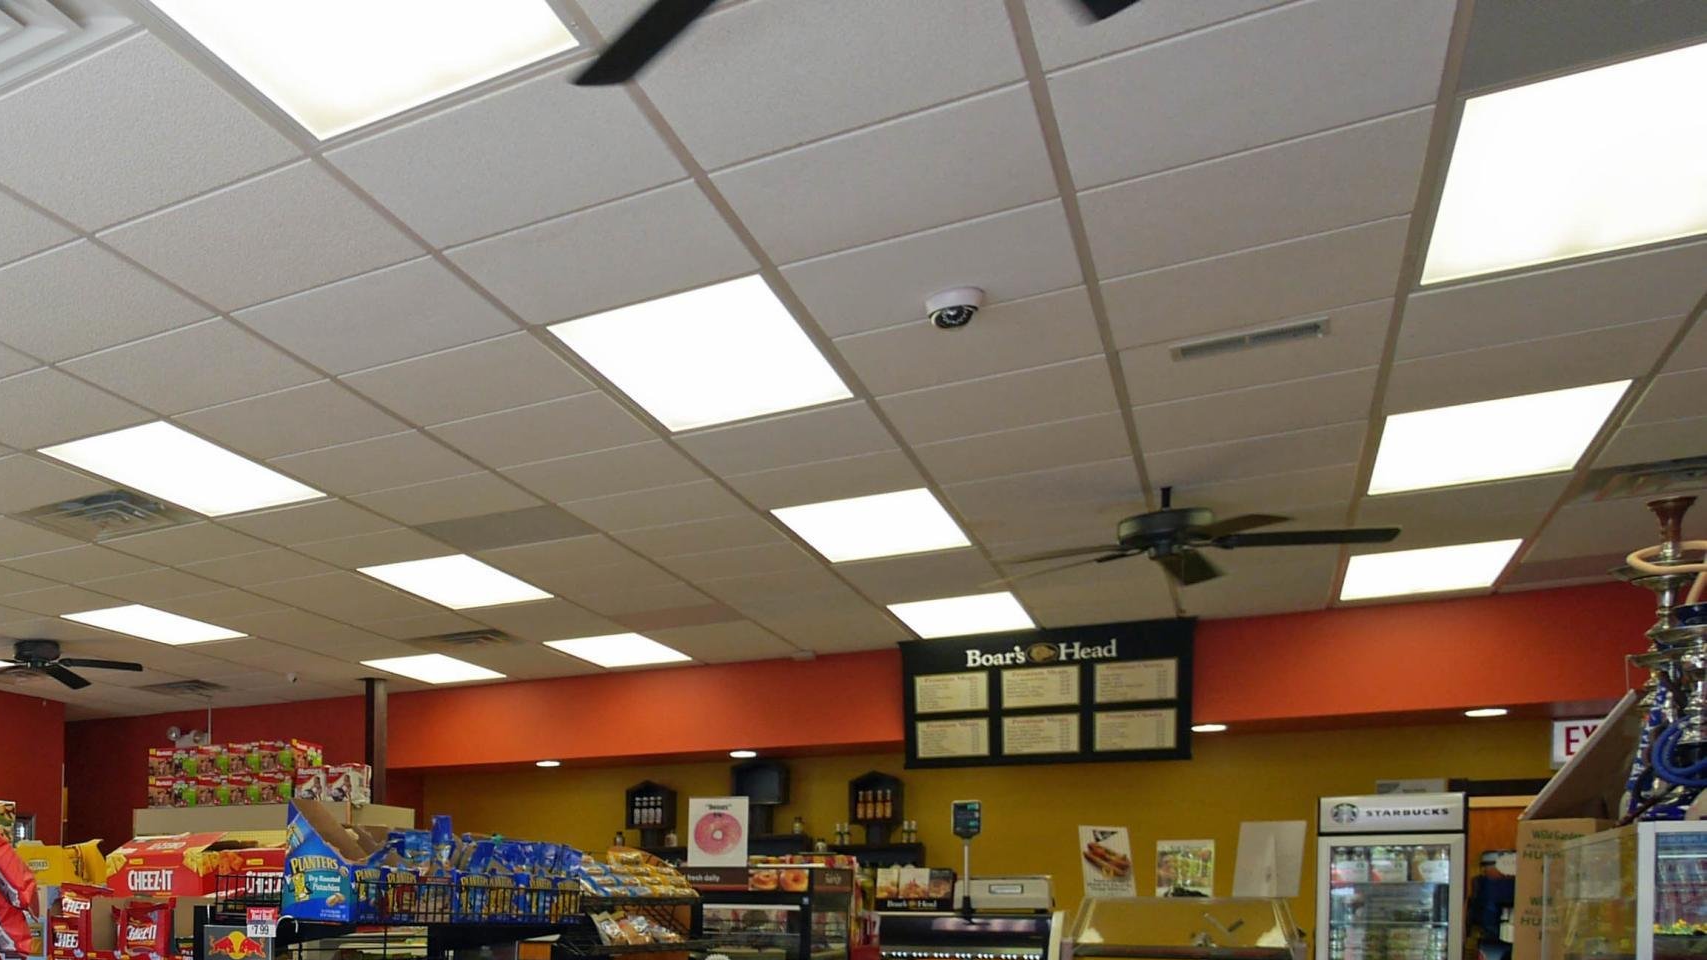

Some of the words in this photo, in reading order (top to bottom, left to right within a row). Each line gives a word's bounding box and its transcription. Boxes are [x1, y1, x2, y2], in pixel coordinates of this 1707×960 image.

[965, 645, 1026, 668] Boar's
[1058, 639, 1118, 662] Head
[1365, 807, 1449, 818] STARBUCKS
[290, 855, 339, 872] PLANTERS
[308, 875, 318, 884] Dry
[318, 875, 341, 883] Roasted
